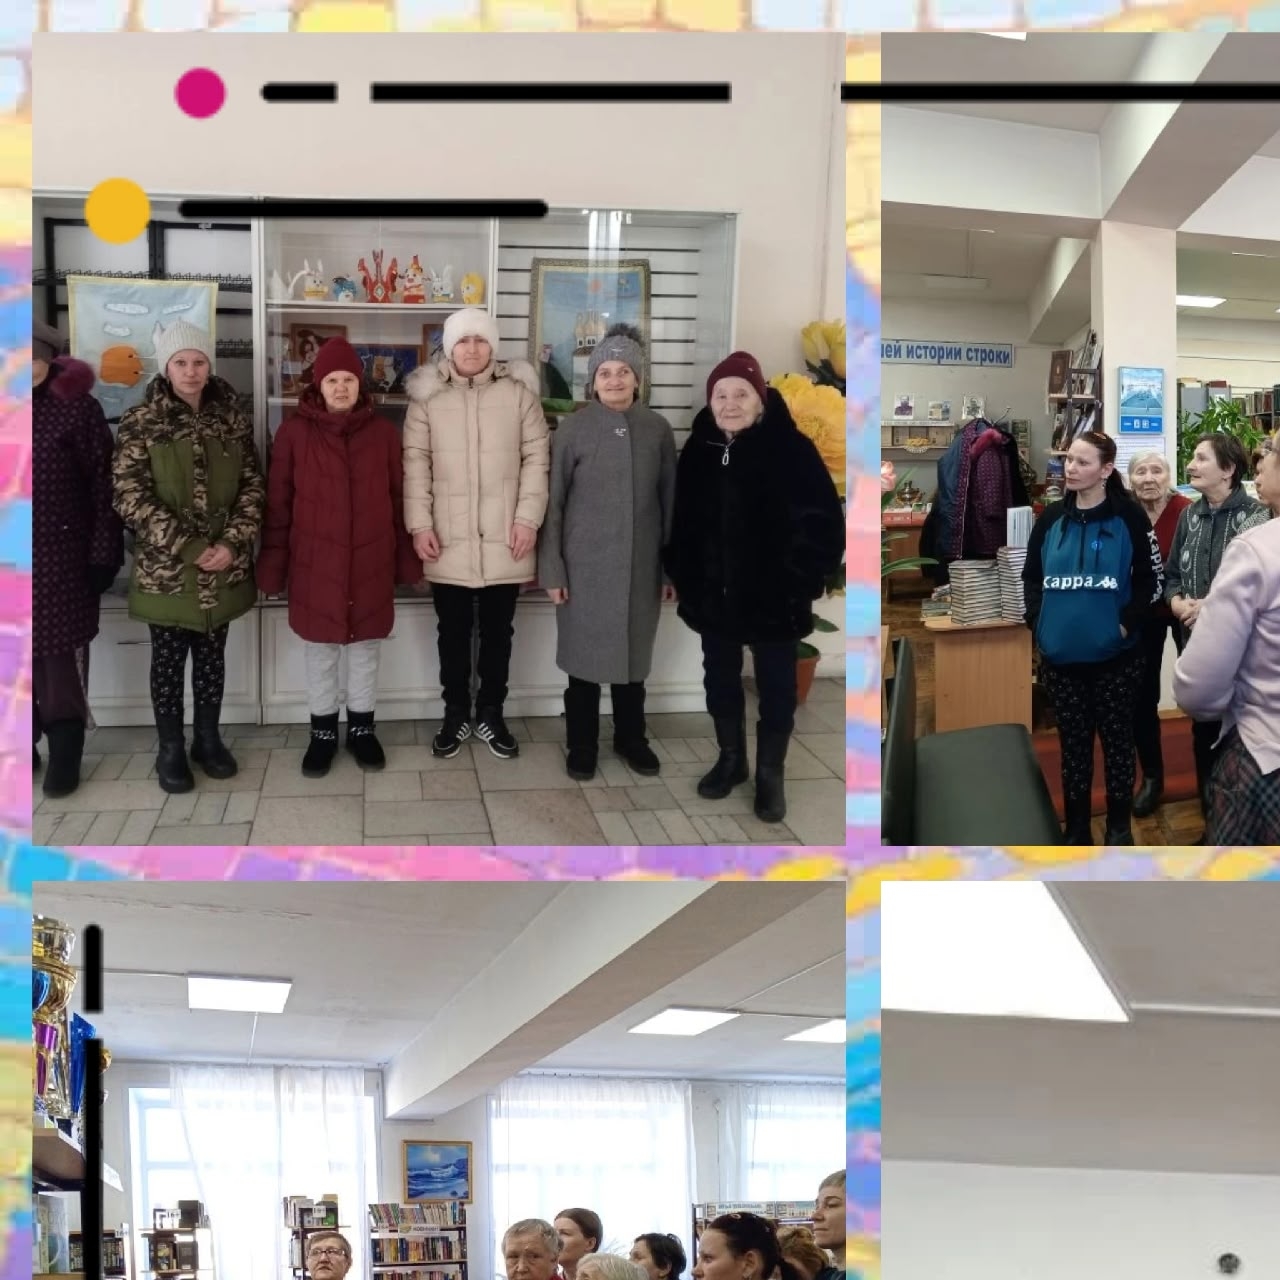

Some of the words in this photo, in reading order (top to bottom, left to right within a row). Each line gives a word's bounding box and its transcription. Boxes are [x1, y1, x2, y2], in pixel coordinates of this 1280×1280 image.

[881, 340, 902, 359] ей
[906, 343, 962, 365] истории
[966, 346, 1010, 366] строки
